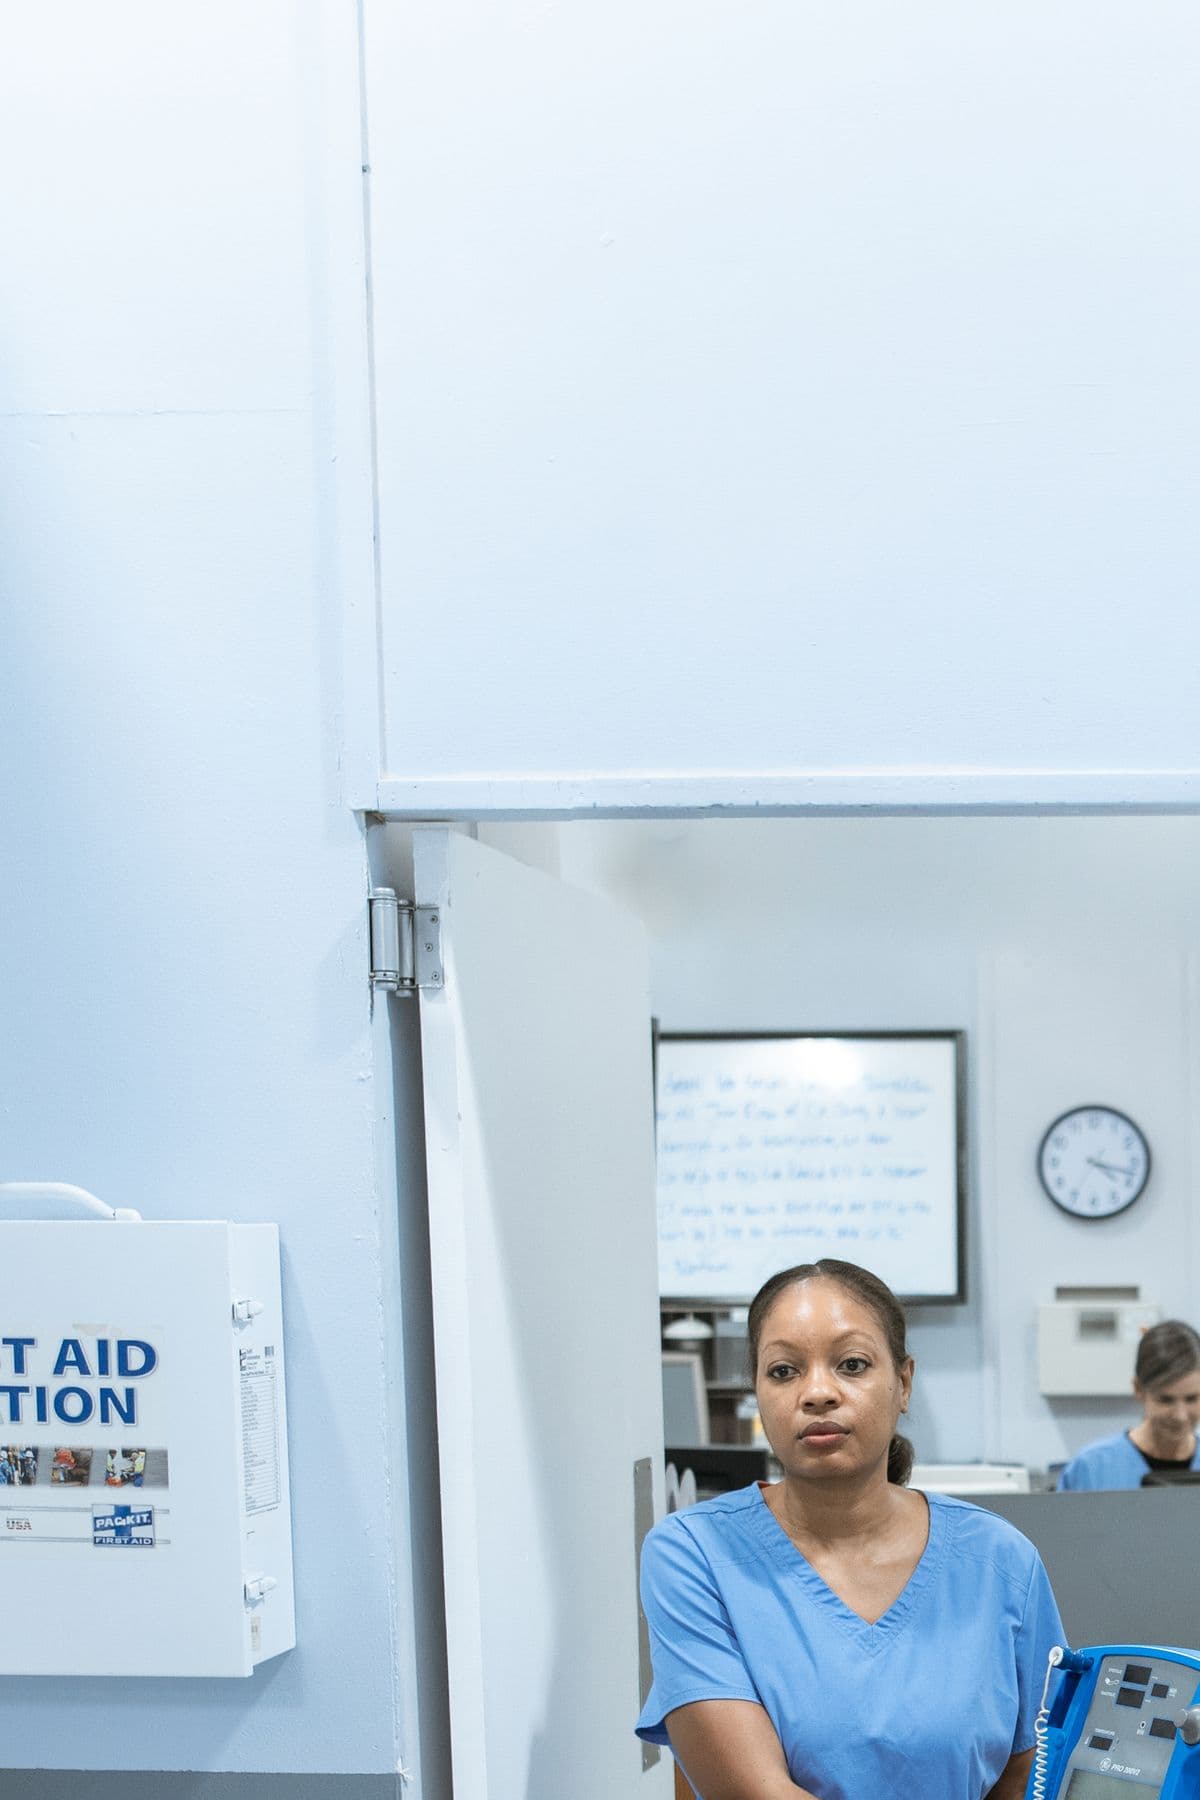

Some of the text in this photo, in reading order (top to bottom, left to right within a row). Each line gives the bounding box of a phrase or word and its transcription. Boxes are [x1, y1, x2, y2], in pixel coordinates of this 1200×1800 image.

[0, 1338, 156, 1377] T AID
[0, 1385, 136, 1424] TION
[6, 1519, 32, 1530] USA
[95, 1536, 129, 1544] FIRST
